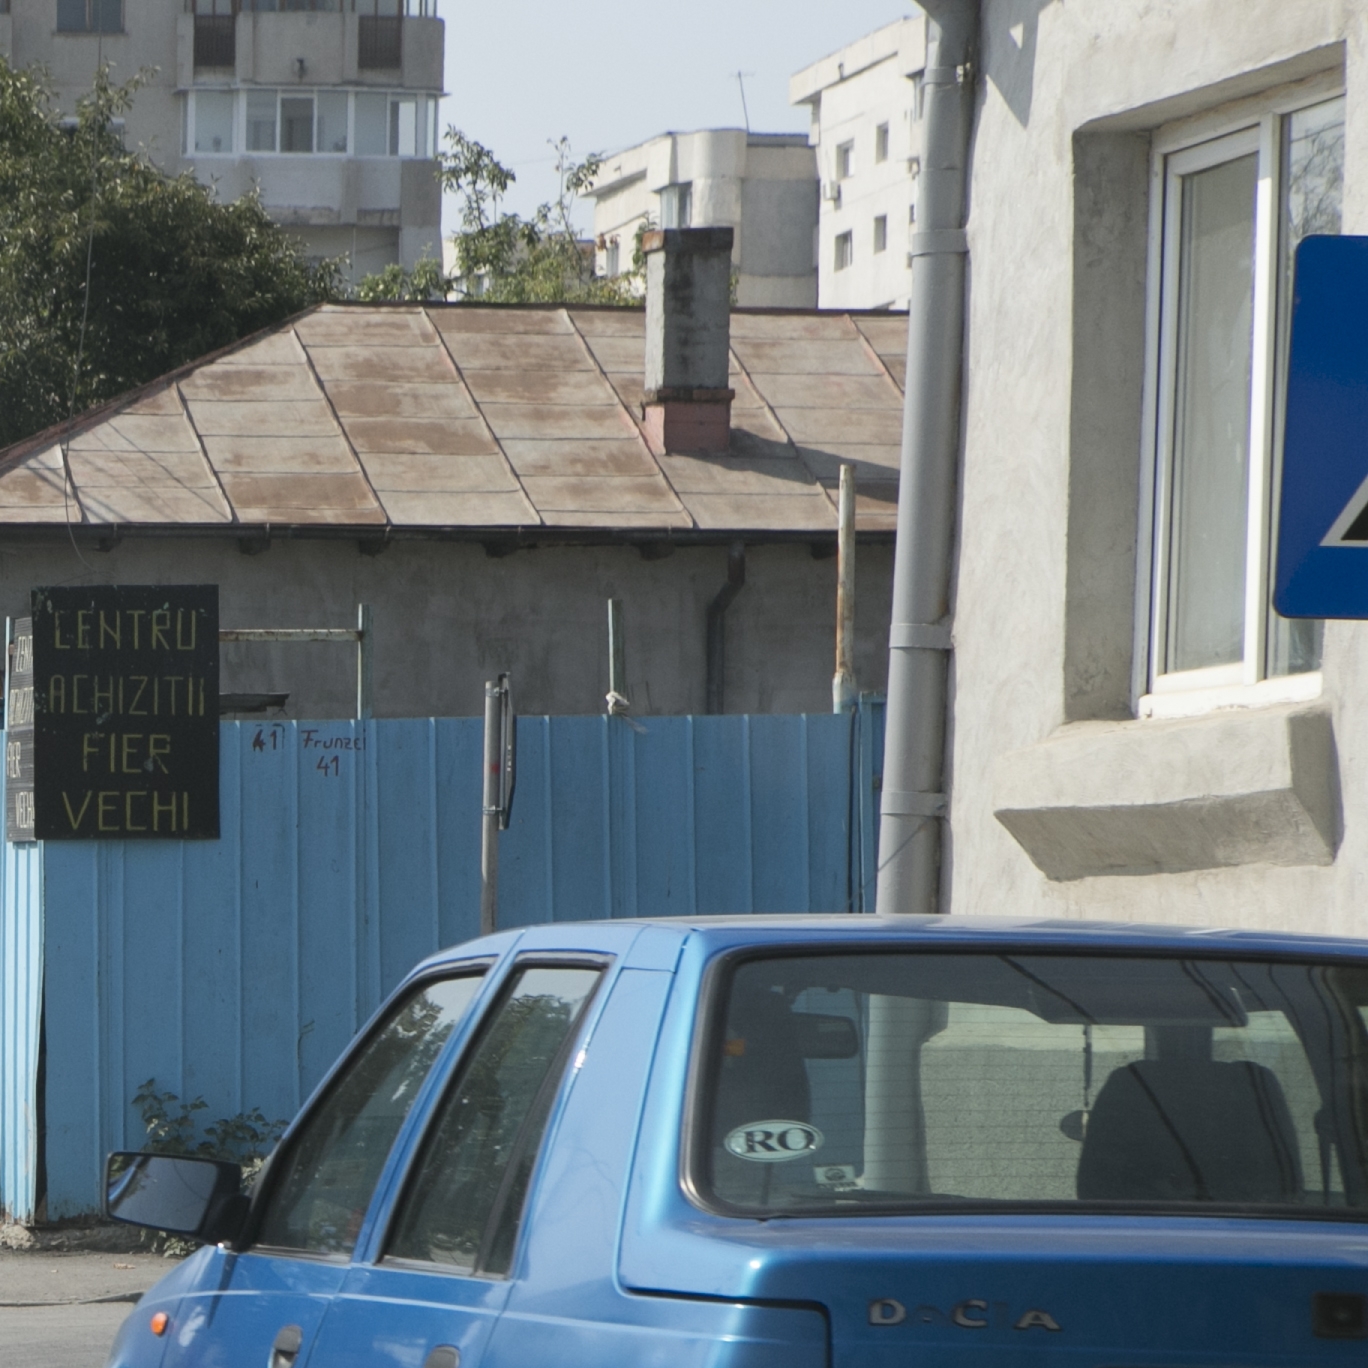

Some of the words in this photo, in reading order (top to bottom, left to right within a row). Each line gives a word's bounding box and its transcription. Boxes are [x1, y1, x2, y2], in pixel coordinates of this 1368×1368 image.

[54, 609, 196, 650] CENTRU
[49, 674, 204, 717] ACHIZITII
[82, 733, 171, 774] FIER
[316, 754, 340, 778] 41
[62, 790, 189, 831] VECHI
[744, 1127, 815, 1153] RO
